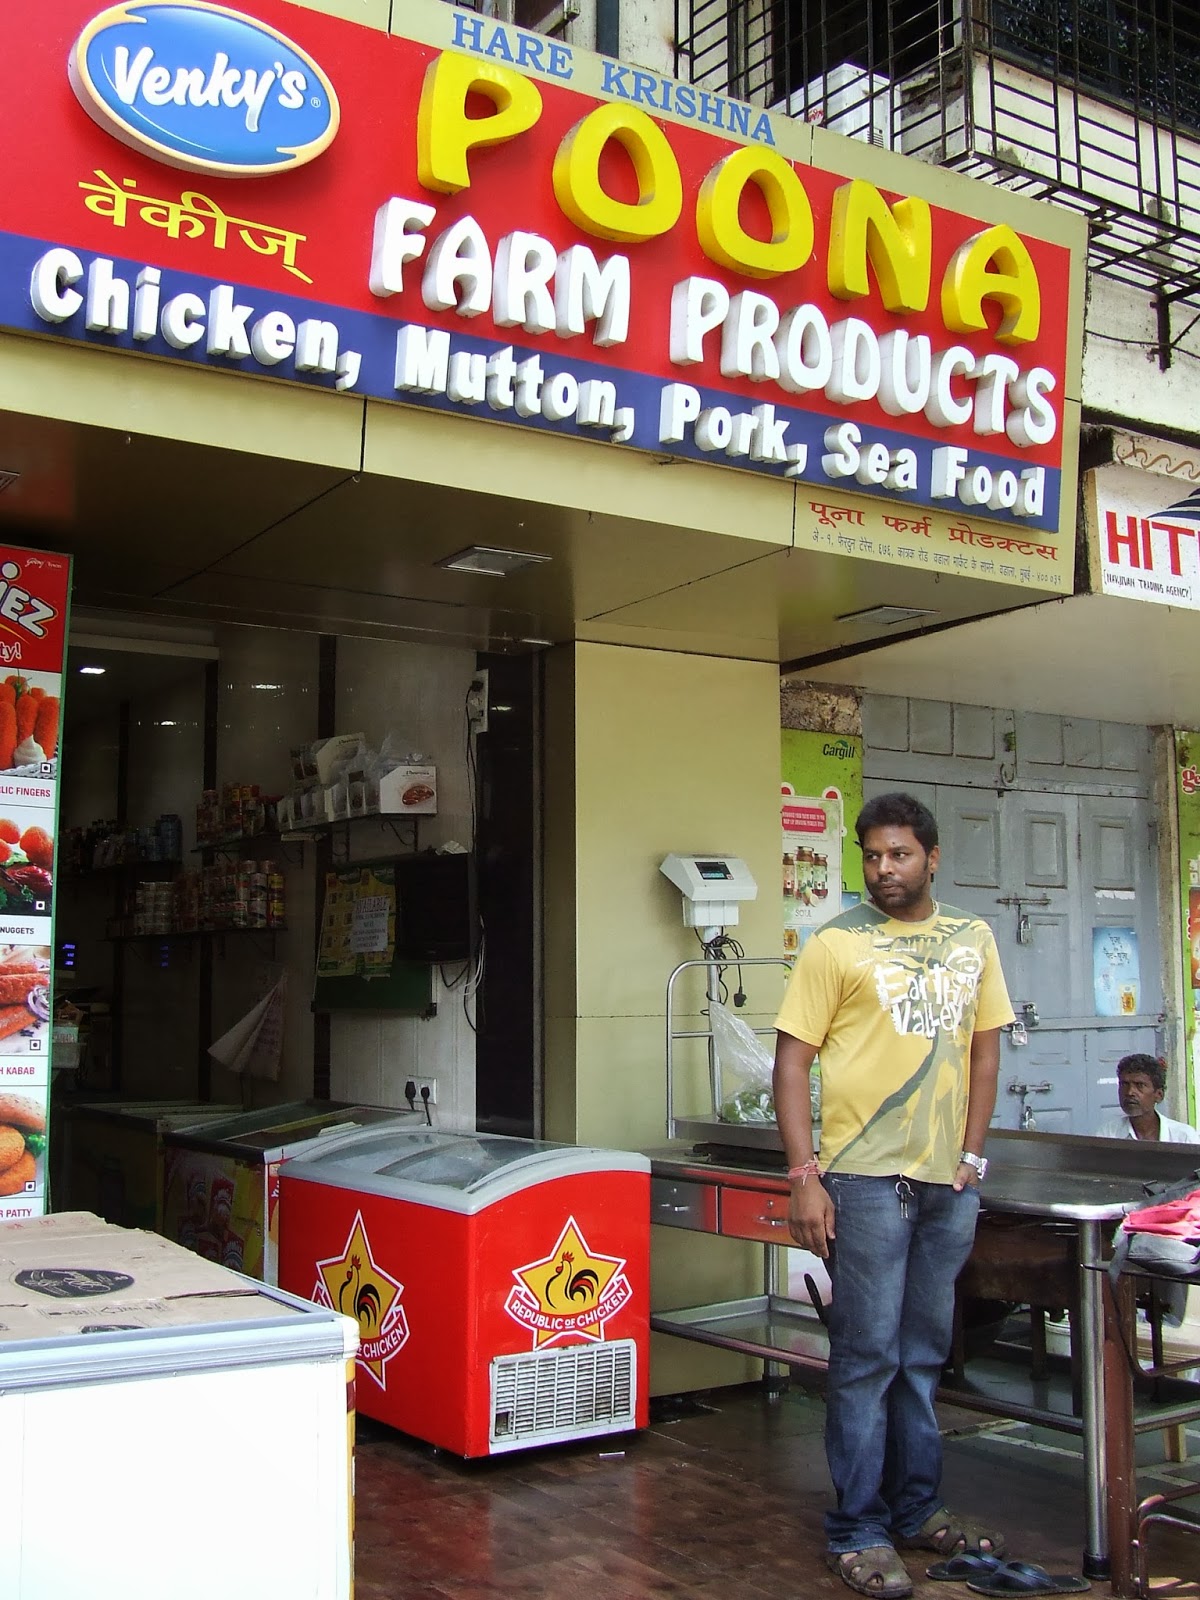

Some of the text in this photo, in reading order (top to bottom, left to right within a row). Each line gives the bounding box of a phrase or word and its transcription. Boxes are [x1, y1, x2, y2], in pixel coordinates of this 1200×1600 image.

[114, 46, 307, 133] Venky's
[451, 13, 776, 146] HARE KRISHNA
[417, 50, 1041, 345] POONA
[78, 169, 313, 284] वेंकीज्
[368, 196, 1056, 448] FARM PRODUCTS
[30, 248, 1045, 519] Chicken, Mutton, Pork, Sea Food
[808, 501, 1058, 560] पूना फर्म प्रोडक्टस
[1105, 510, 1200, 577] HIT
[1138, 579, 1164, 594] TRADING
[822, 743, 855, 760] Cargill
[0, 786, 51, 797] LIC FINGERS
[0, 926, 35, 935] NUGGETS
[6, 1066, 35, 1075] KABAB
[6, 1208, 32, 1218] PATTY
[510, 1299, 563, 1330] REPUBLIC
[576, 1288, 627, 1327] CHICKEN
[364, 1322, 404, 1358] CHICKEN
